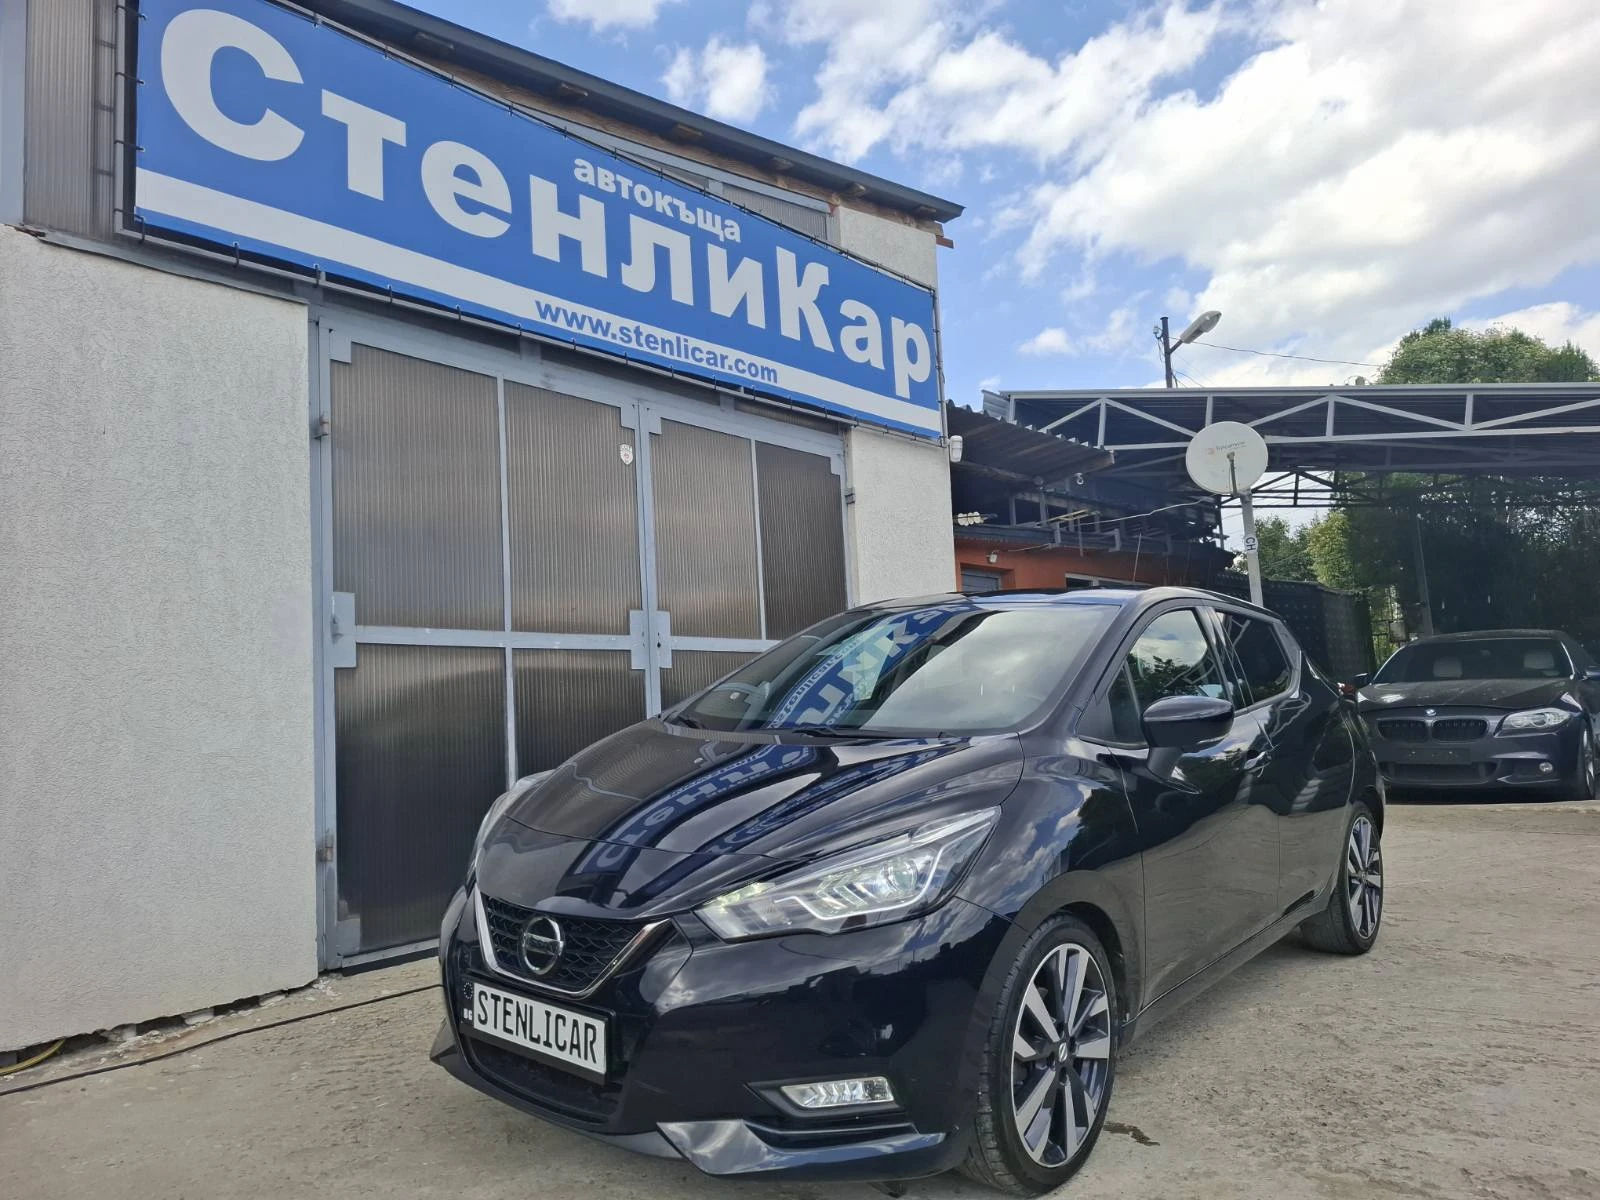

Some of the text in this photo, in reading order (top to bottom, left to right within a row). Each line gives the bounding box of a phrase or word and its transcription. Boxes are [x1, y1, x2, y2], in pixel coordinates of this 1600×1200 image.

[160, 8, 933, 399] СтенлиКар
[573, 158, 741, 243] автокъща
[535, 300, 778, 384] www.stenlicar.com
[477, 990, 597, 1063] STENLICAR
